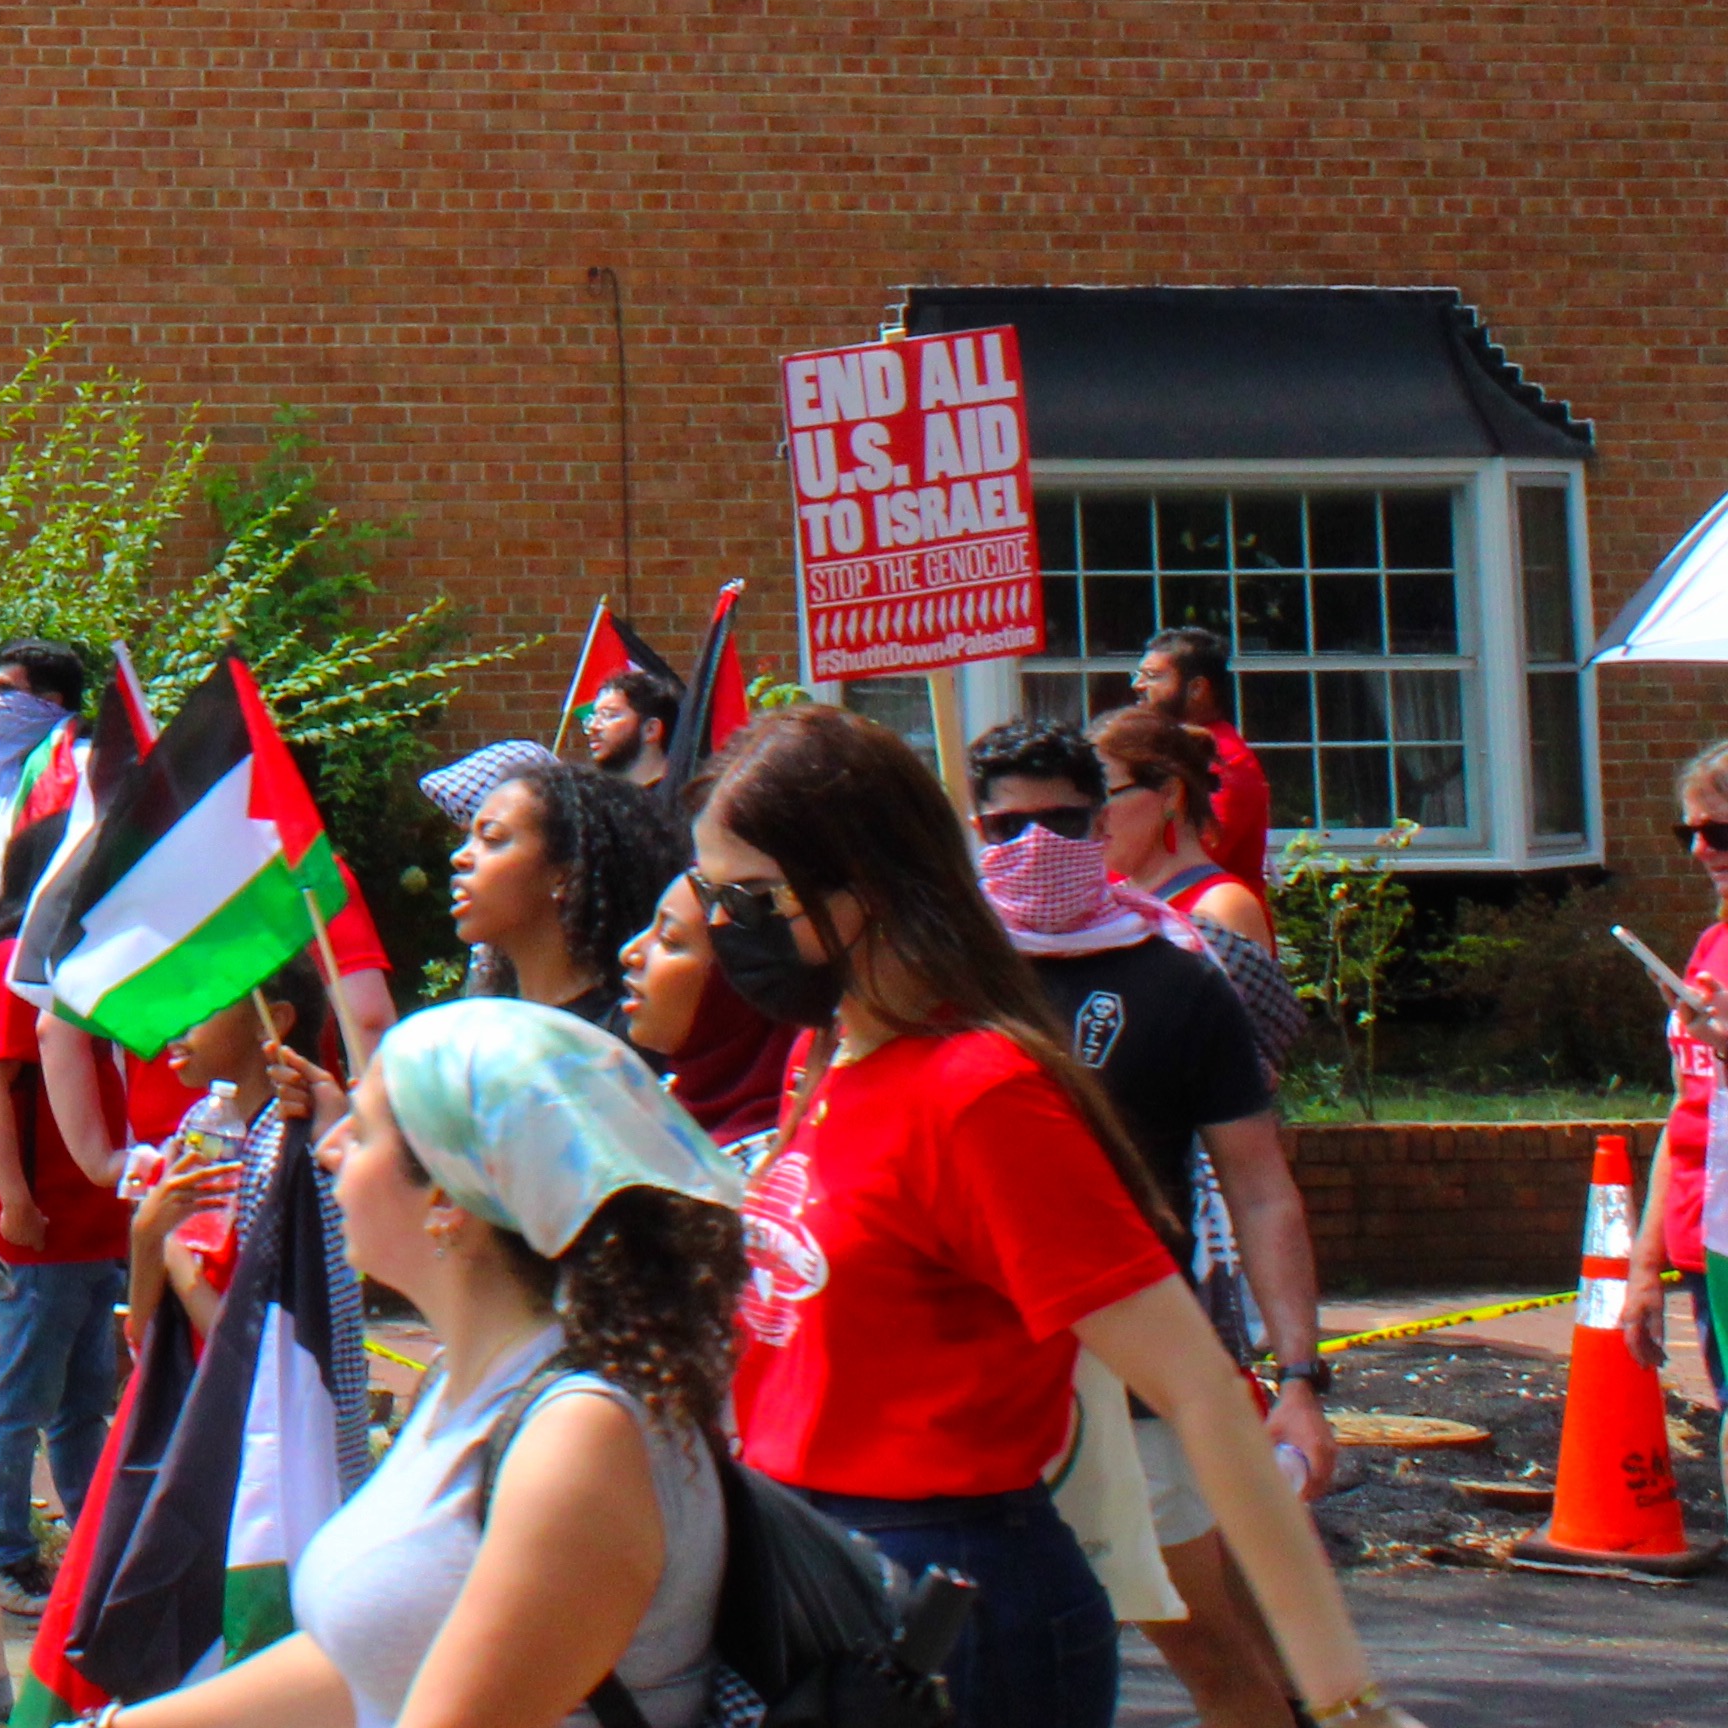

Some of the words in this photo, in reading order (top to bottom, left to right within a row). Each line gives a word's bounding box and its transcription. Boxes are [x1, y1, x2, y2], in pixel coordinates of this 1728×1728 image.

[784, 349, 907, 427] END
[919, 333, 1018, 410] ALL
[792, 421, 912, 498] U.S.
[923, 404, 1021, 482] AID
[800, 498, 865, 558] TO
[874, 474, 1029, 548] ISRAEL
[809, 562, 871, 604] STOP
[876, 553, 922, 597] THE
[923, 537, 1032, 589] GENOCIDE
[815, 624, 1037, 677] #ShutItDown4Palestine
